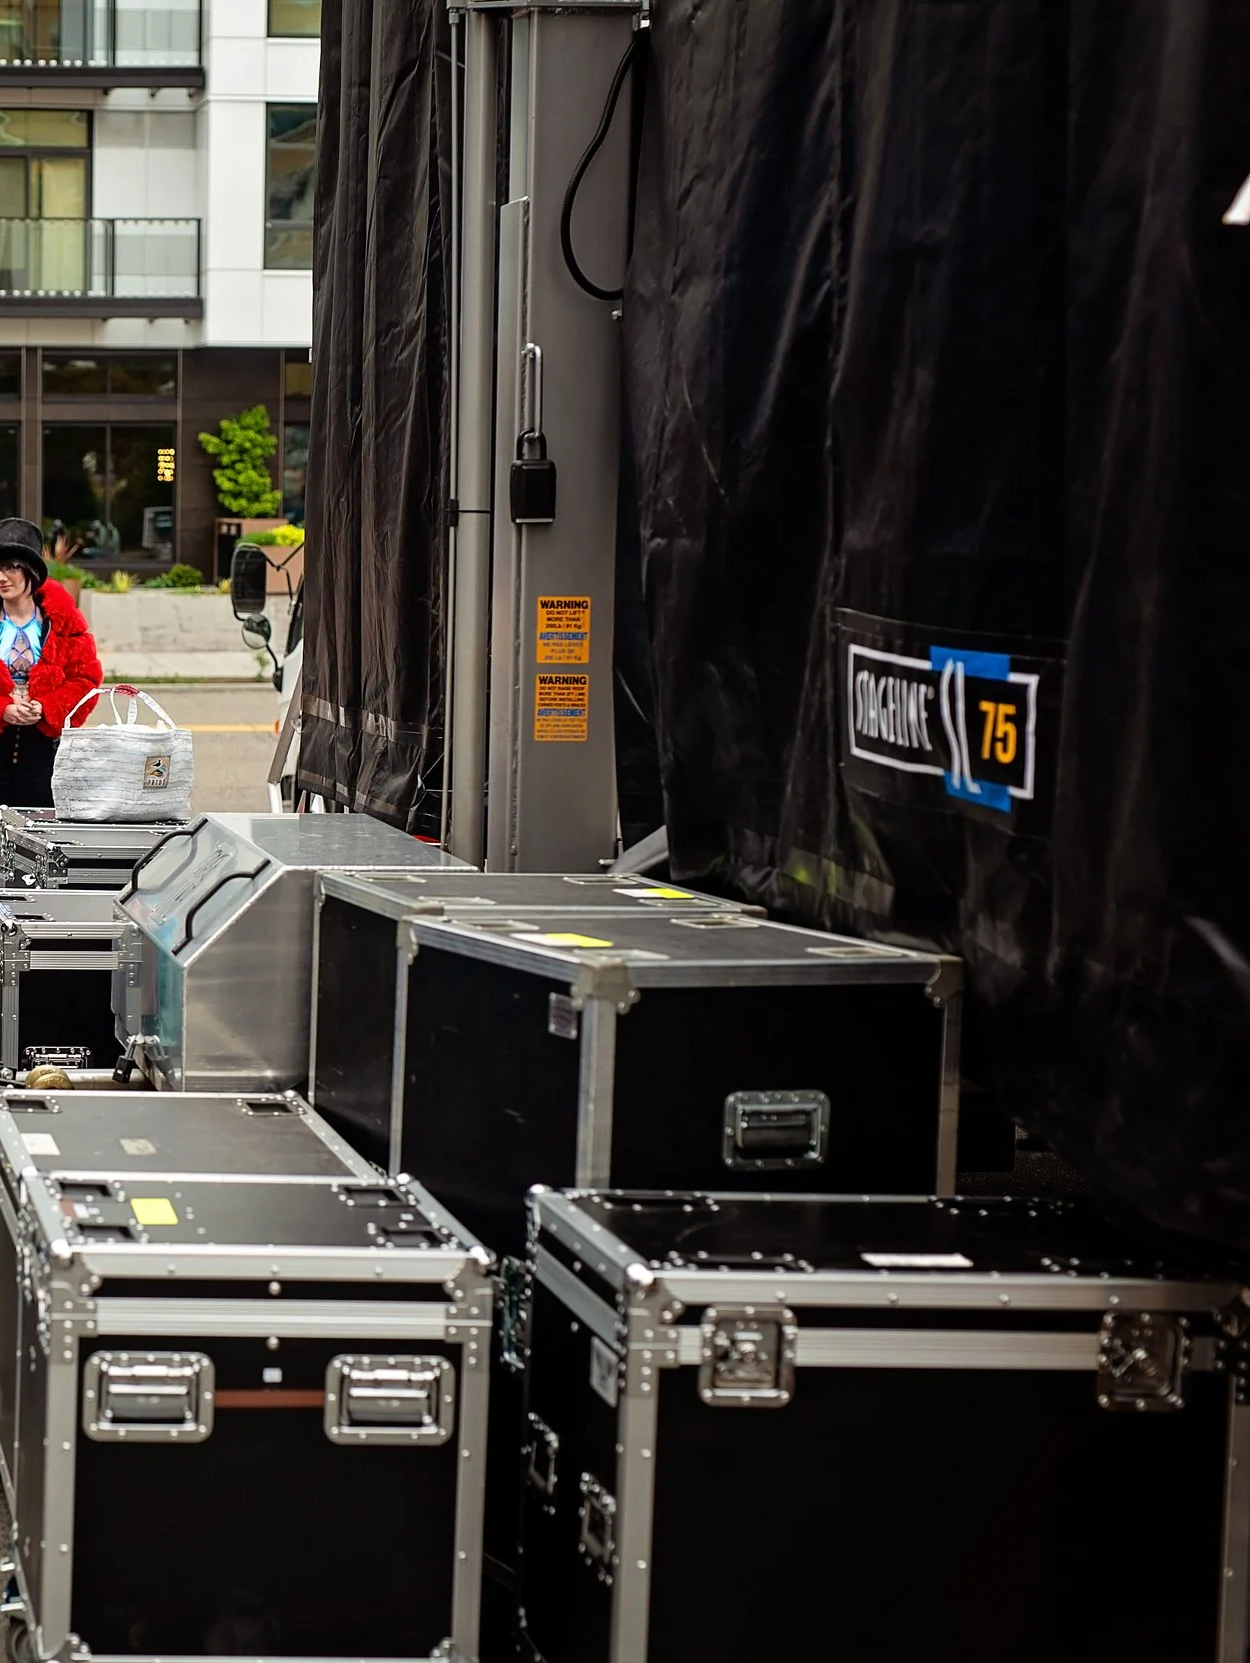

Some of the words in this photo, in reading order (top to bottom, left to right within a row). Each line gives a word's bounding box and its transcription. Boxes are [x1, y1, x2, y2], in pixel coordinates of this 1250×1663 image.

[540, 600, 589, 609] WARNING
[538, 676, 587, 685] WARNING
[979, 700, 1017, 764] 75
